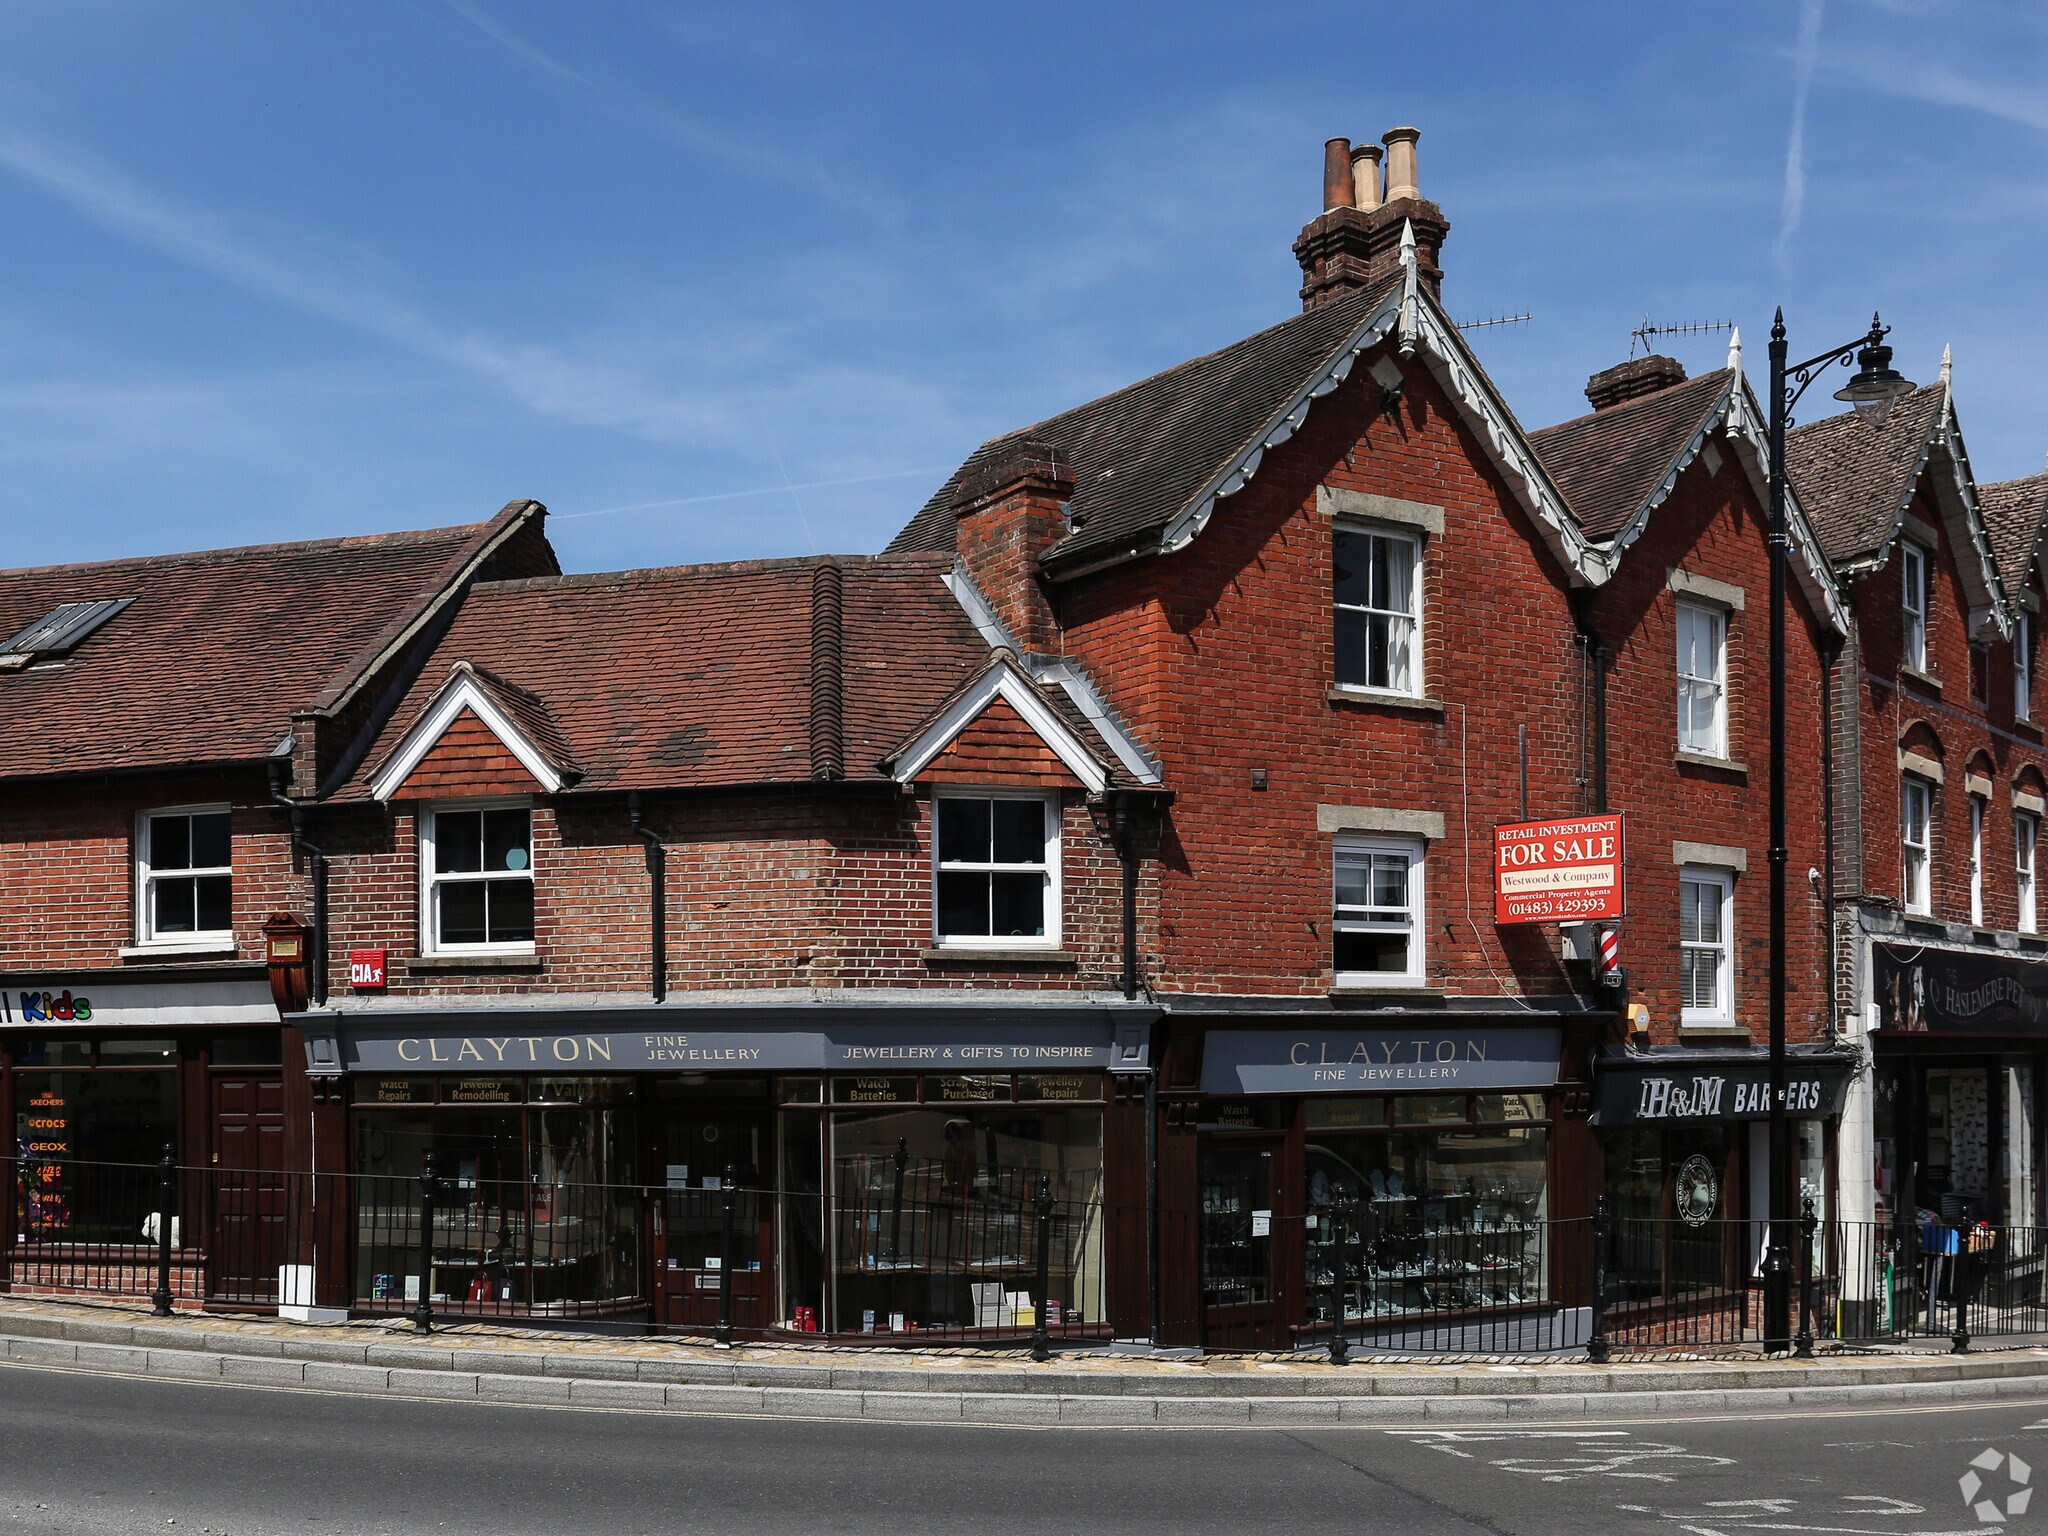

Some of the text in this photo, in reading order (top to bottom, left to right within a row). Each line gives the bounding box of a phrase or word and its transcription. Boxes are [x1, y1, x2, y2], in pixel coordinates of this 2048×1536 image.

[1498, 821, 1617, 841] RETAIL INVESTMENT
[1500, 836, 1616, 867] FOR SALE
[1504, 871, 1611, 886] Westwood & Company
[1504, 889, 1611, 902] Commercial Property Agents
[1508, 898, 1606, 916] (01483) 429393
[351, 963, 373, 983] CIA
[1945, 977, 2025, 1017] HASLEMERE PET
[20, 989, 92, 1023] Kids
[397, 1036, 689, 1062] CLAYTON FINE
[647, 1048, 761, 1060] JEWELLERY
[842, 1046, 1093, 1059] JEWELLERY & GIFTS TO INSPIRE
[1290, 1040, 1487, 1066] CLAYTON
[1313, 1068, 1461, 1081] FINE JEWELLERY
[856, 1078, 890, 1089] Watch
[1035, 1077, 1083, 1089] Jewellery
[378, 1089, 412, 1102] Repairs
[452, 1089, 511, 1102] Remodelling
[850, 1089, 897, 1101] Batteries
[942, 1088, 995, 1100] Purchased
[1041, 1088, 1078, 1101] Repairs
[1636, 1077, 1821, 1118] H&M BARERS
[1221, 1104, 1249, 1115] Watch
[1503, 1108, 1525, 1117] epairs
[35, 1119, 66, 1128] crocs
[30, 1142, 67, 1151] GEOX
